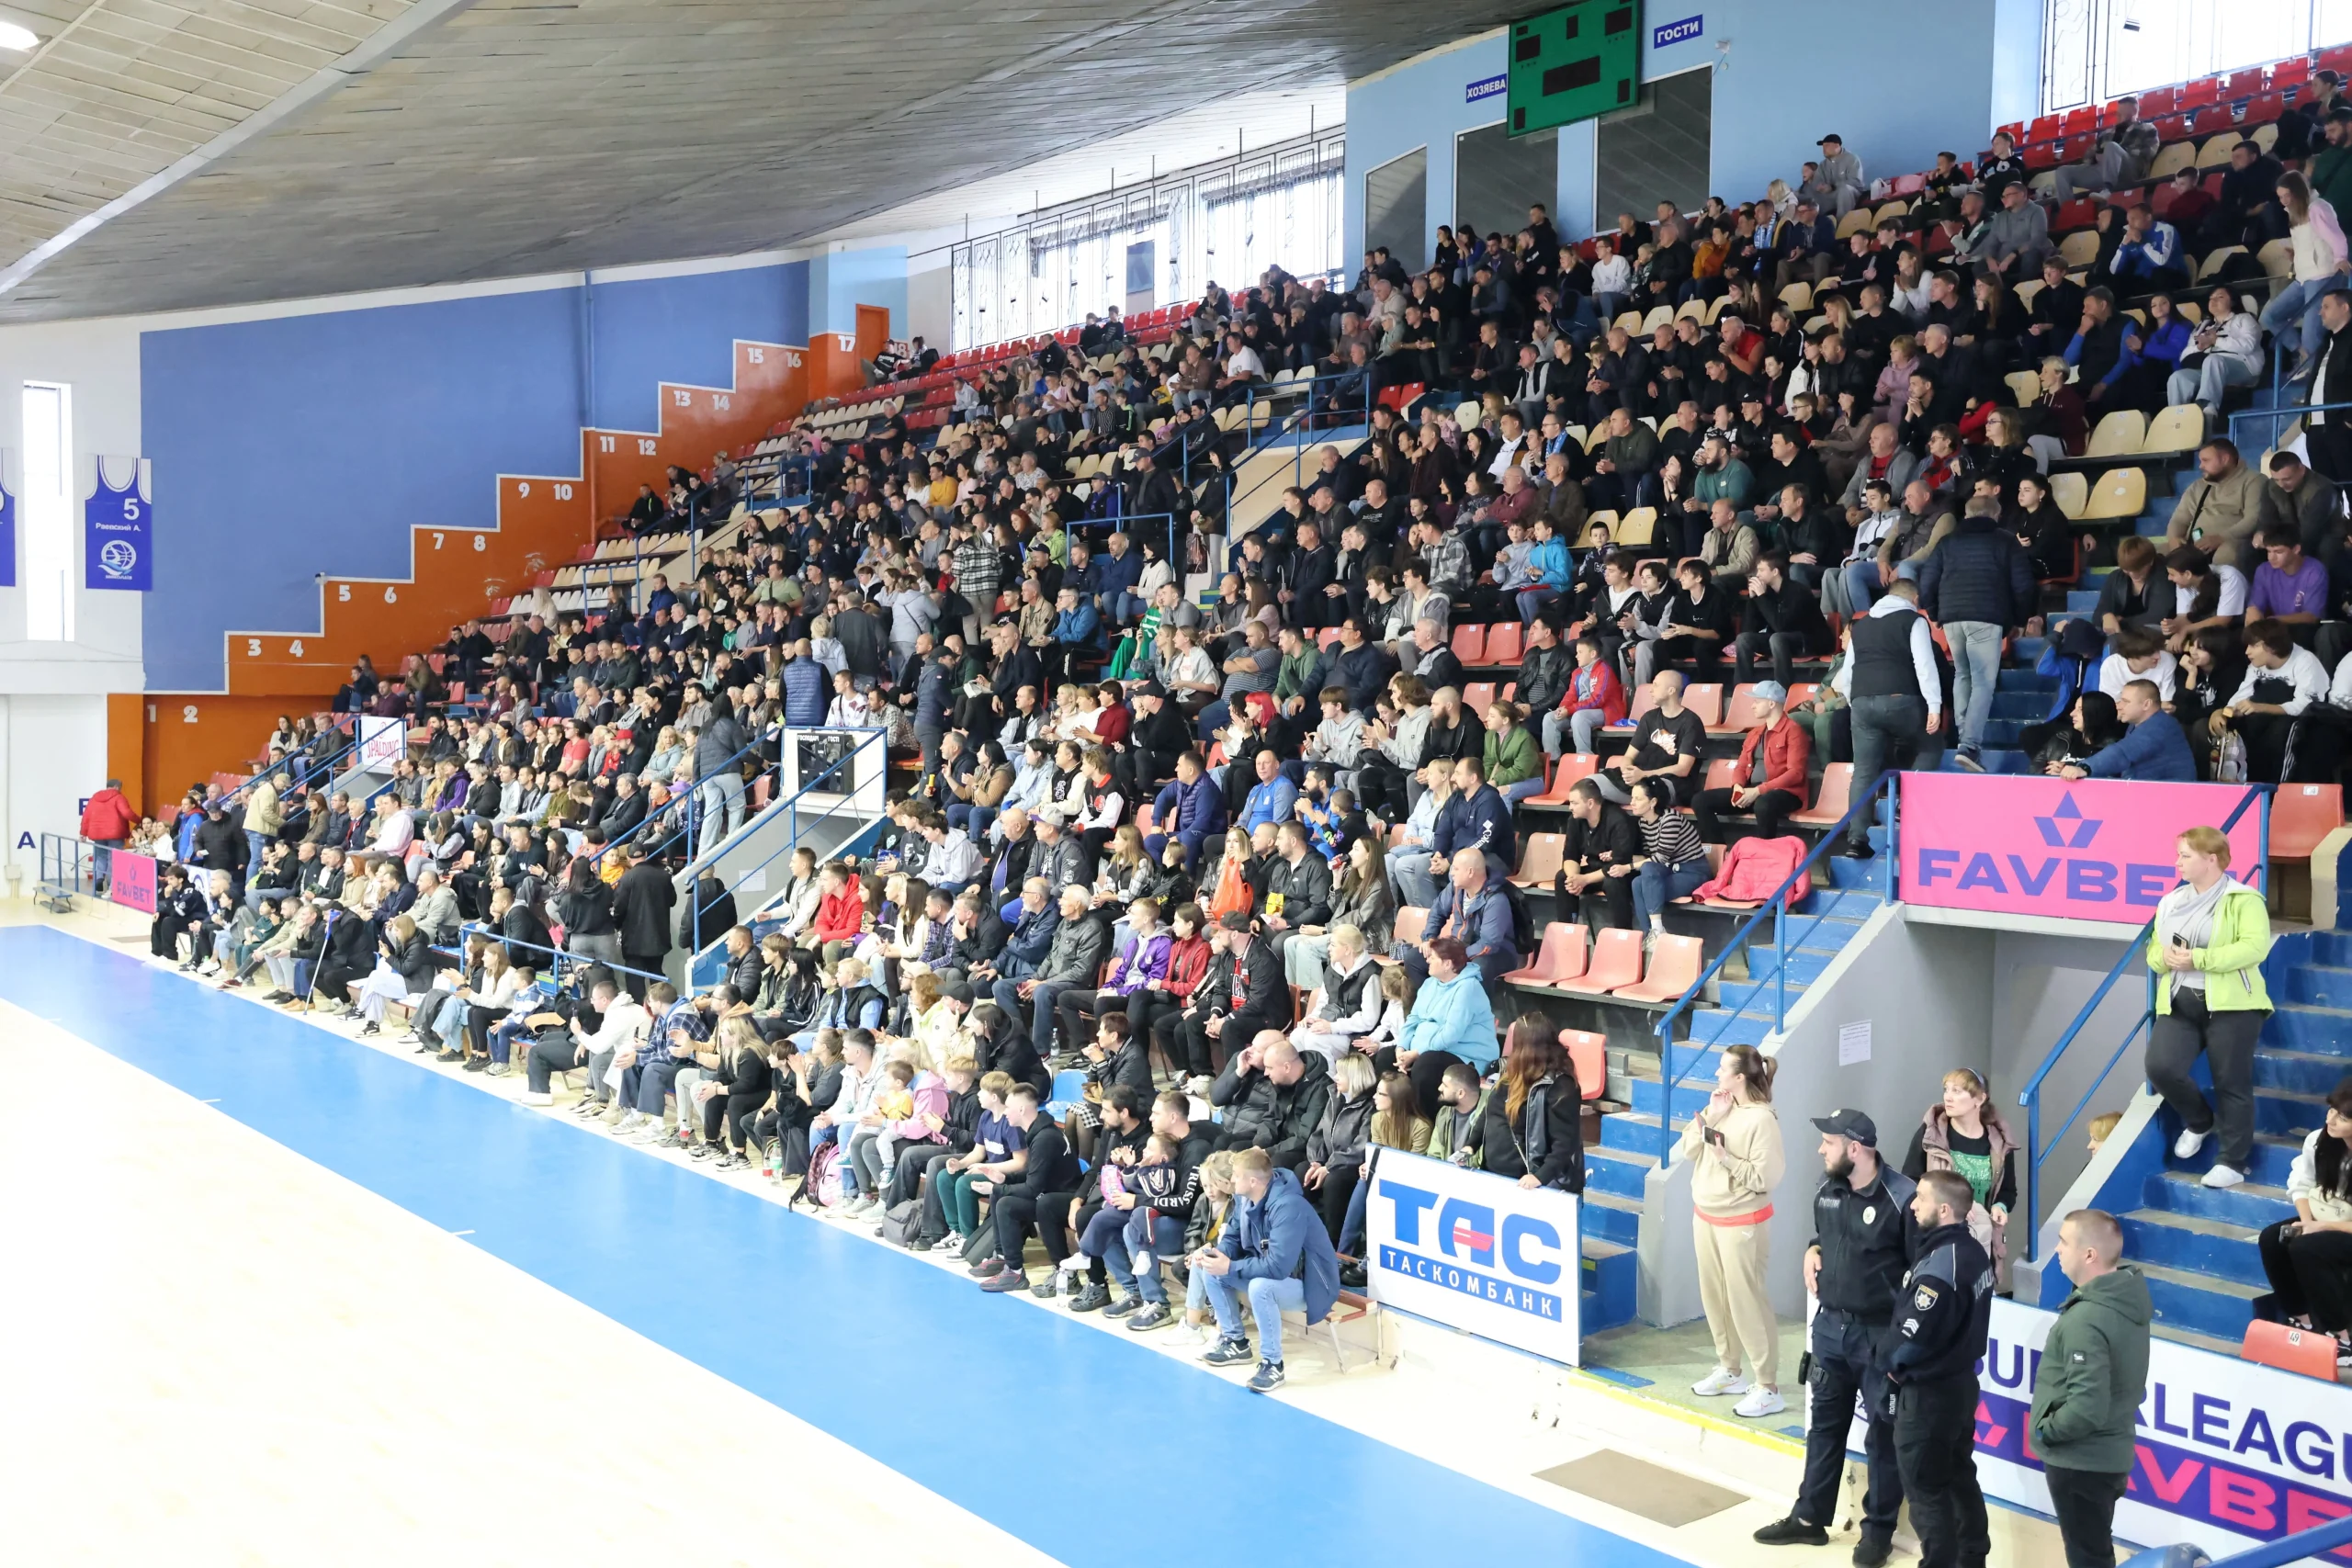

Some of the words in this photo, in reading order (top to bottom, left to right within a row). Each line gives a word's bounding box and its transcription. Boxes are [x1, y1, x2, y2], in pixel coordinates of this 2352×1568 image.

[1657, 20, 1700, 44] ГОСТИ
[1466, 78, 1507, 99] ХОЗЯЕВА
[838, 334, 855, 352] 17
[747, 347, 763, 364] 15
[786, 352, 802, 367] 16
[673, 389, 691, 407] 13
[712, 393, 730, 411] 14
[600, 436, 615, 452] 11
[638, 438, 657, 456] 12
[519, 482, 530, 499] 9
[554, 483, 571, 501] 10
[123, 498, 140, 521] 5
[434, 533, 445, 549] 7
[473, 534, 486, 551] 8
[338, 584, 351, 602] 5
[384, 586, 397, 604] 6
[247, 638, 262, 657] 3
[288, 639, 304, 658] 4
[147, 705, 156, 723] 1
[183, 705, 198, 723] 2
[368, 738, 400, 761] SPALDING
[1918, 848, 2237, 907] FAVBE
[117, 881, 151, 905] FAVBET
[1379, 1179, 1562, 1285] ТАС
[1387, 1250, 1553, 1317] ТАСКОМБАНК
[2290, 1332, 2300, 1343] 49
